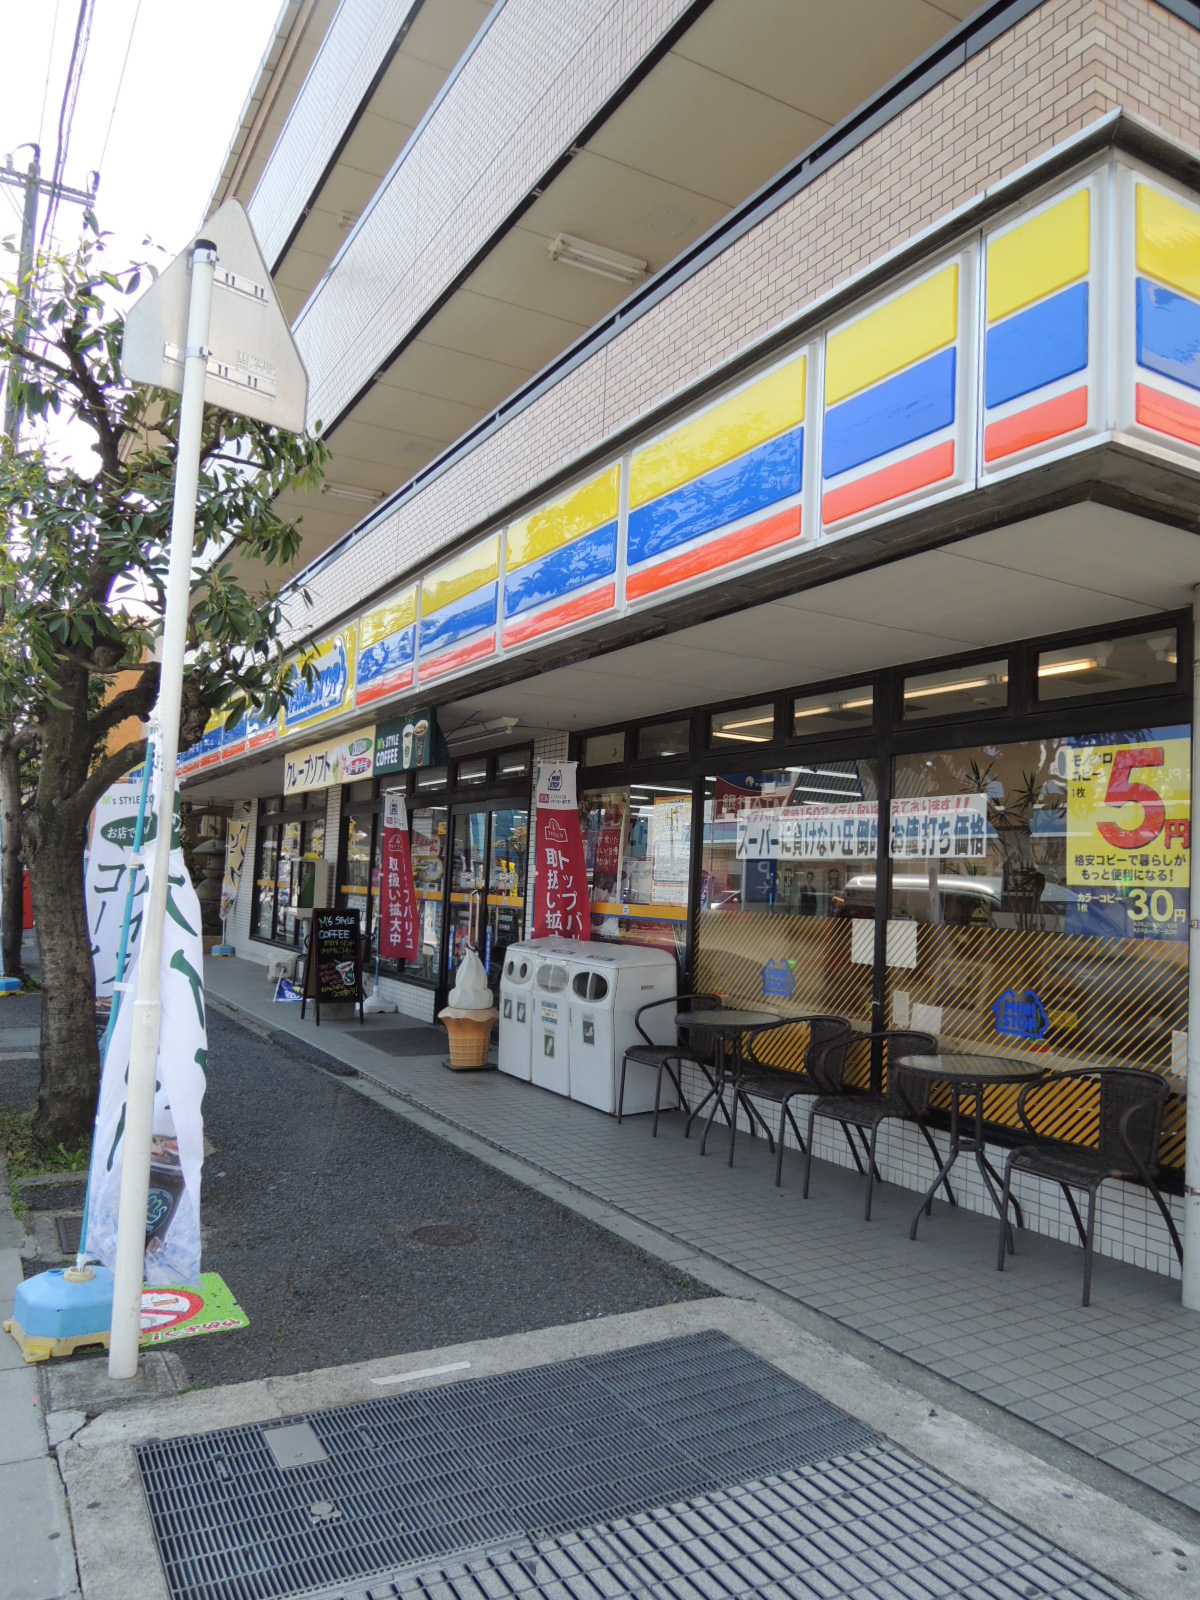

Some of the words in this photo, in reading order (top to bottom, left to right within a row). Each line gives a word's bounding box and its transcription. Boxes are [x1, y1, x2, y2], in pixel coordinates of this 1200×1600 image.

[386, 733, 400, 747] STYLE
[376, 747, 399, 767] COFFEE
[1072, 752, 1113, 767] モノクロ
[286, 750, 331, 791] クレープソフト
[1072, 787, 1086, 798] 1枚
[119, 795, 140, 805] STYLE
[1074, 854, 1187, 867] 格安コピーで暮らしが
[1081, 868, 1174, 882] もっと便利になる!
[388, 856, 402, 946] 取扱い拡大中
[558, 849, 583, 941] トップバ
[1077, 893, 1123, 904] カラーコピー
[1077, 903, 1088, 913] 1枚
[335, 915, 355, 925] STYLE
[318, 929, 350, 939] COFFEE
[1004, 1001, 1036, 1017] MINI
[1002, 1016, 1039, 1033] STOP
